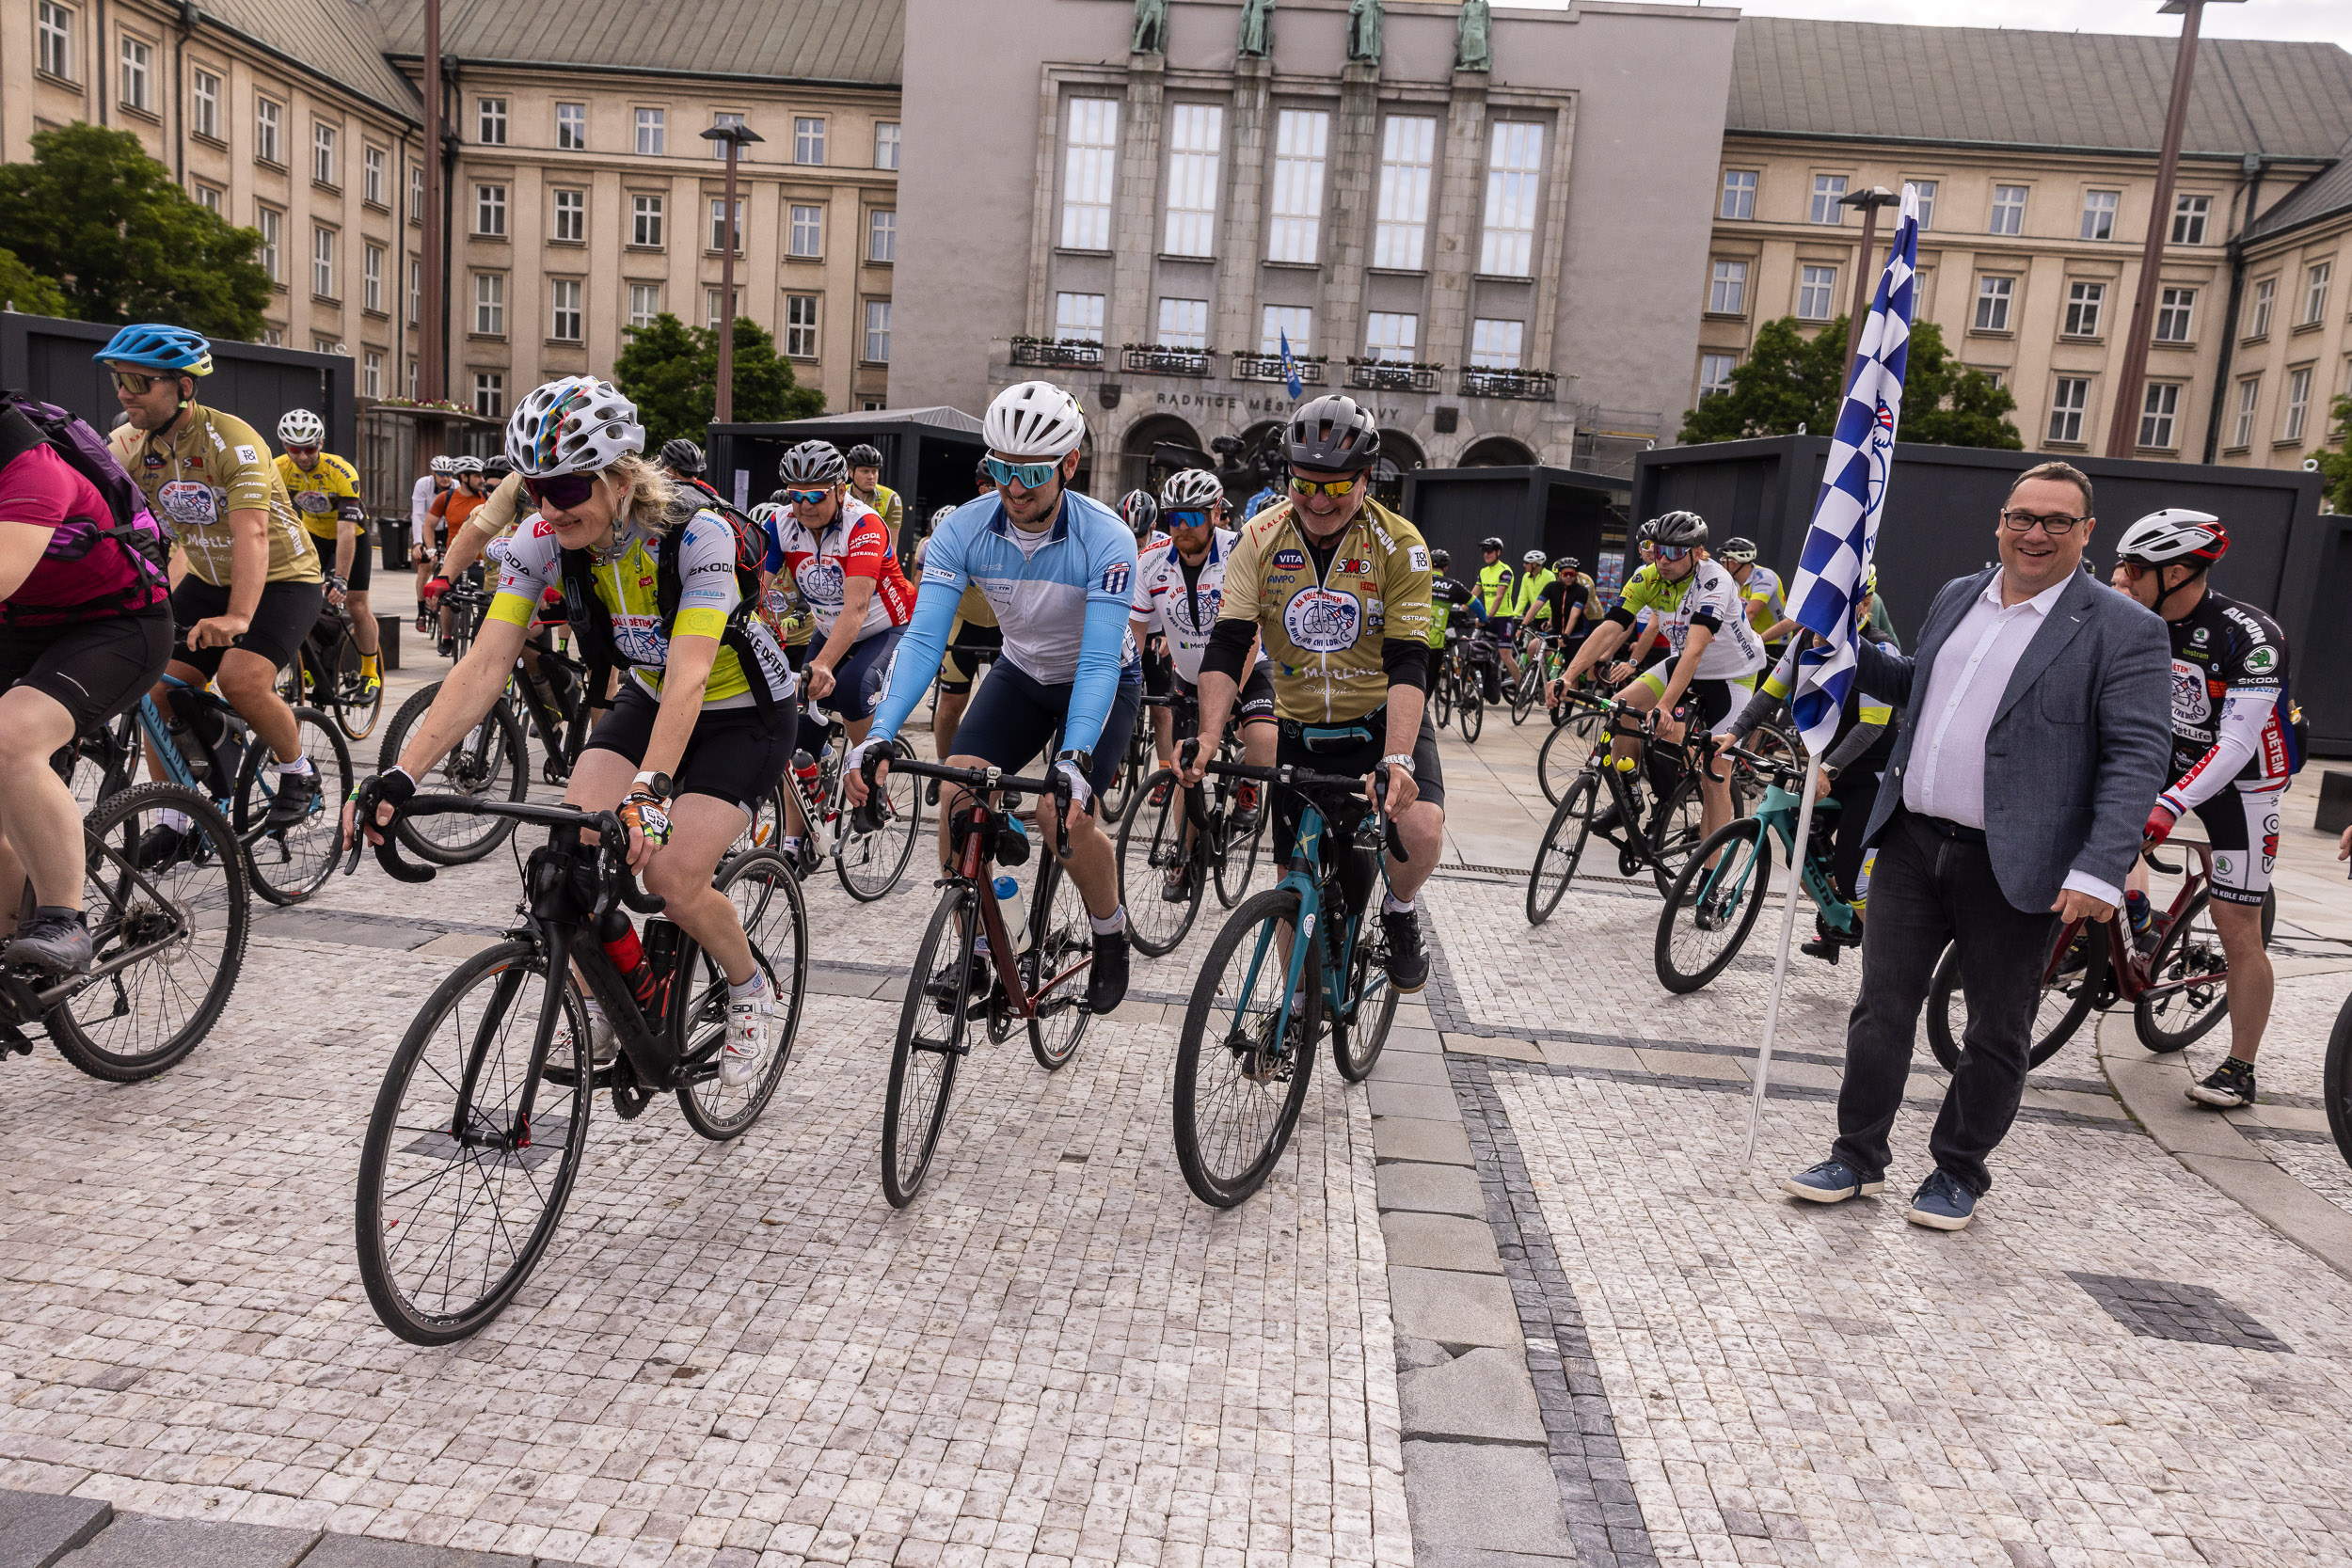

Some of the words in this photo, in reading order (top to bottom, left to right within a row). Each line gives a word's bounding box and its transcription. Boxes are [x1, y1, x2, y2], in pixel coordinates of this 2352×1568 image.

[1156, 392, 1236, 408] RADNICE
[325, 458, 352, 479] ALFUN
[1279, 554, 1304, 564] VITA
[1335, 558, 1373, 575] SMO
[1266, 575, 1295, 584] AMPO
[887, 586, 900, 607] KOLE
[1294, 598, 1305, 610] NA
[1289, 616, 1296, 626] ON
[2221, 607, 2266, 645] ALFUN
[1290, 627, 1302, 641] BIKE
[760, 646, 787, 685] DĚTEM
[2172, 662, 2189, 674] ĚTEM
[2237, 676, 2280, 685] ŠKODA
[2265, 731, 2286, 774] DĚTEM
[2262, 814, 2280, 875] SMO
[2219, 889, 2238, 900] KOLE
[2238, 894, 2263, 903] DĚTEM
[2118, 895, 2137, 964] REK
[732, 1004, 754, 1014] SIDI
